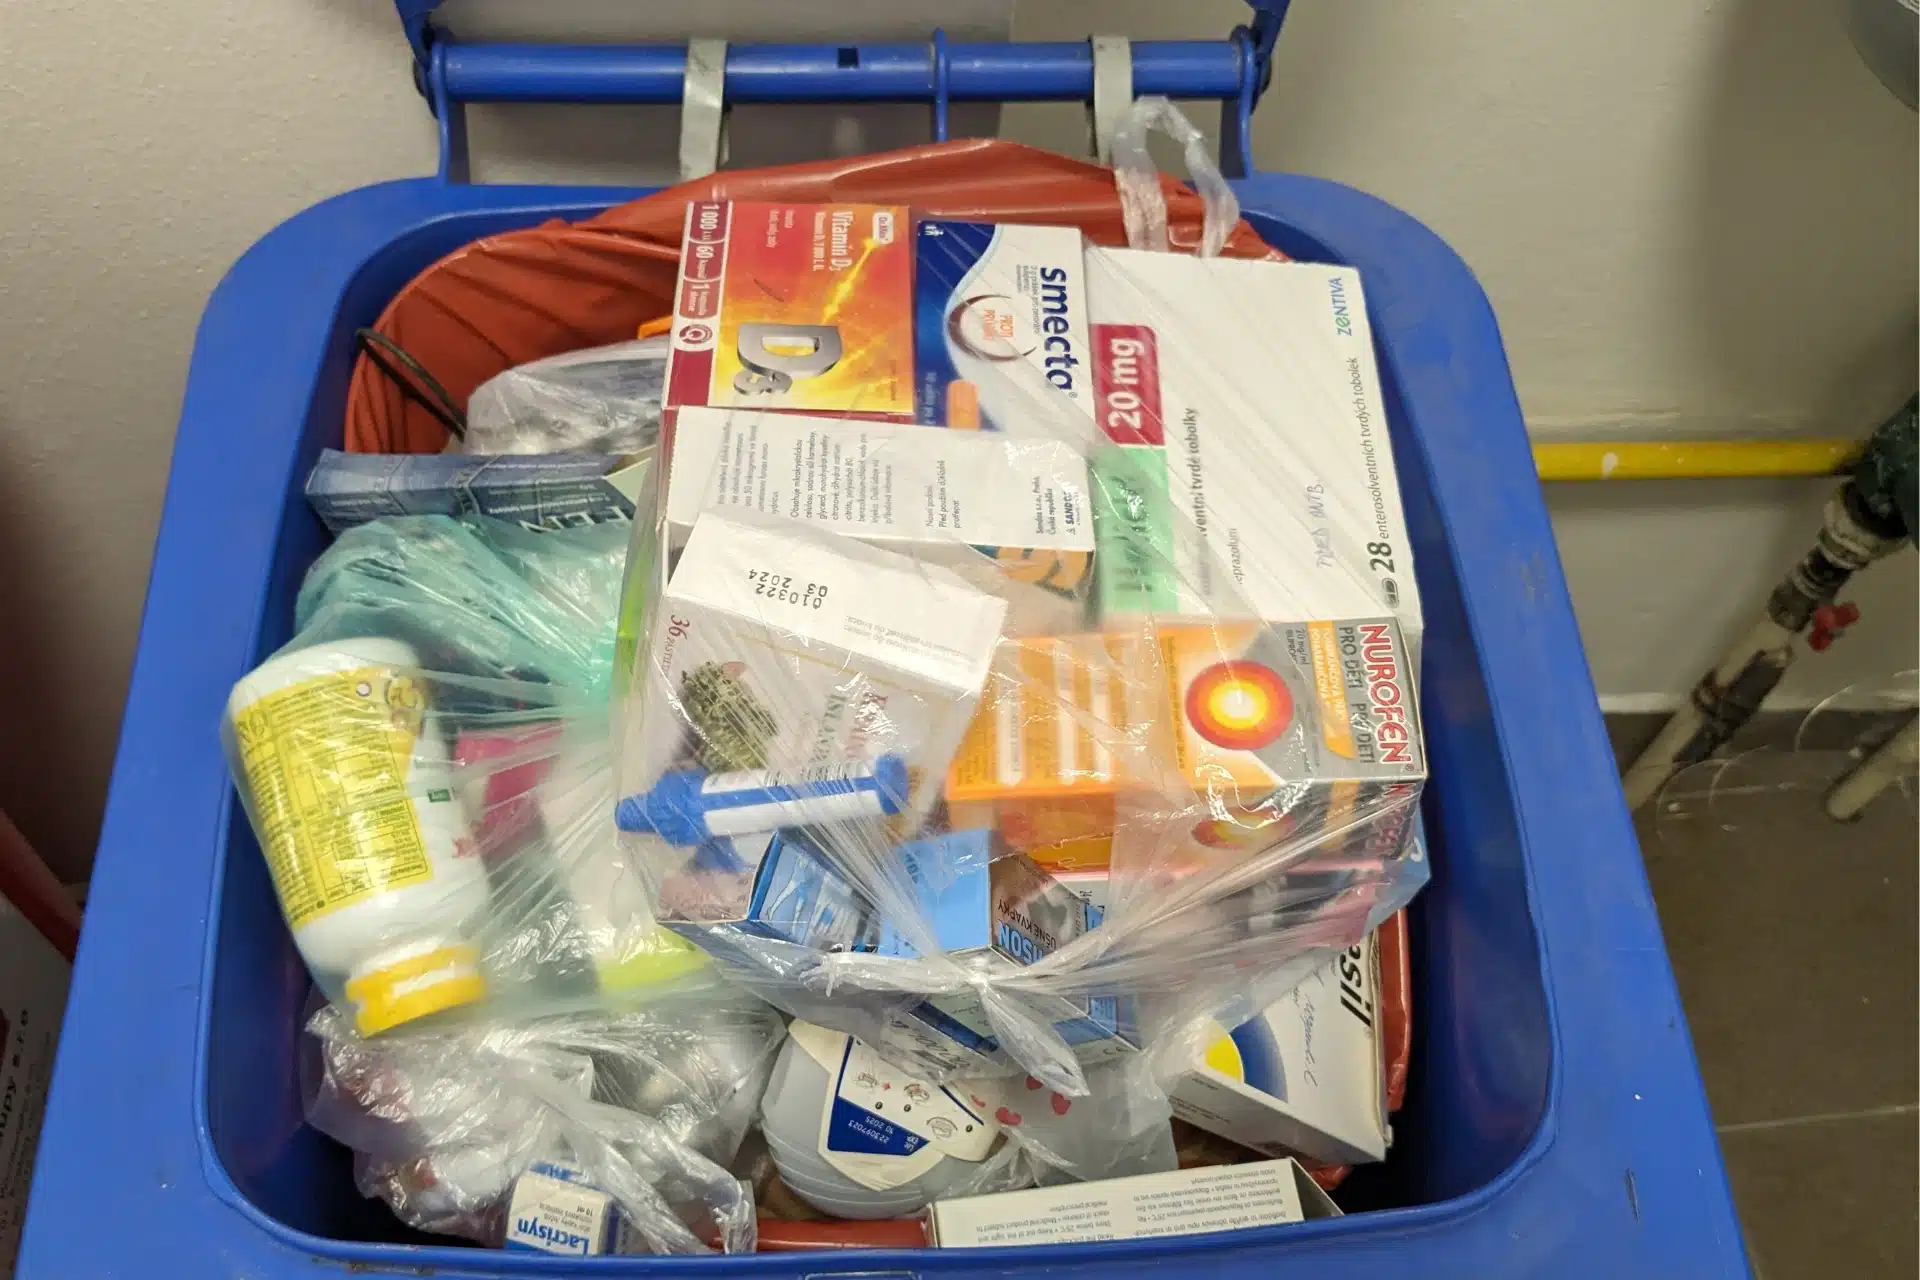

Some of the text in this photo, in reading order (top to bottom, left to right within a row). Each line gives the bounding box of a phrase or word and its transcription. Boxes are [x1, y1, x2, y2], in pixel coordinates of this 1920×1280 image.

[696, 246, 714, 258] 60
[1000, 315, 1014, 337] PROTI
[1040, 267, 1079, 389] smecta
[1108, 338, 1145, 429] 20 mg
[1187, 457, 1203, 489] tvrdé
[1345, 356, 1395, 574] 28 enterosolventních tvrdých tobolek
[748, 568, 829, 598] 03 2024
[755, 582, 822, 610] 010322
[668, 615, 690, 640] 36
[1339, 627, 1356, 656] PRO
[1358, 624, 1412, 764] NUROFEN
[997, 899, 1032, 933] KVAPKY
[865, 1115, 885, 1129] 2025
[518, 1217, 590, 1255] Lacrisyn
